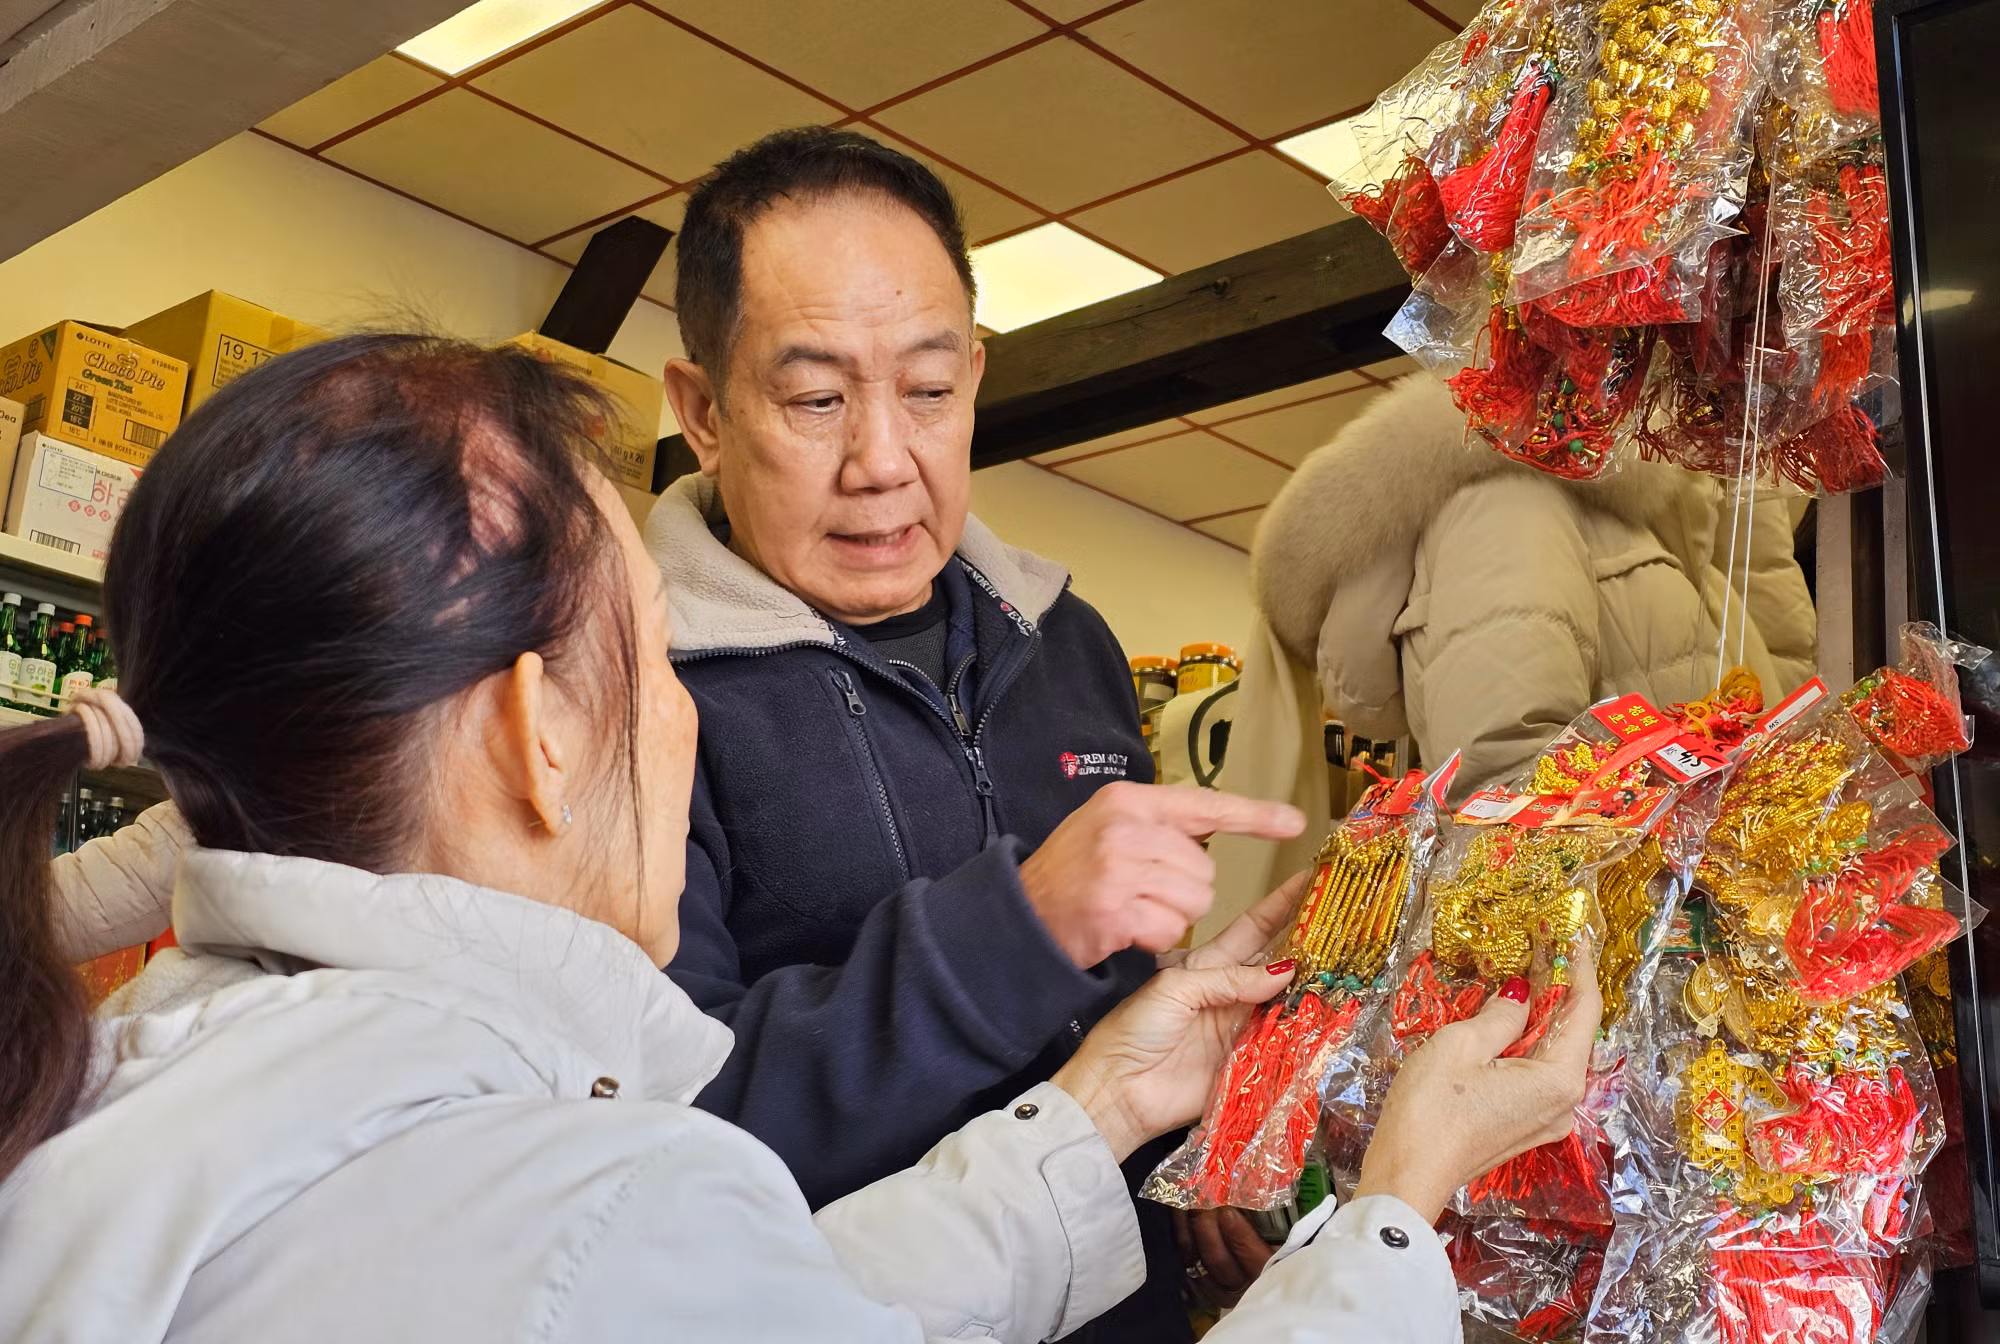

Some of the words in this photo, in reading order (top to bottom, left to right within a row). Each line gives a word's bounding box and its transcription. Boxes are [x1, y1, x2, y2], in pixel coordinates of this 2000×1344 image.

[85, 334, 113, 350] LOTTE
[84, 350, 136, 381] Choco
[135, 367, 166, 391] Pie
[82, 369, 114, 388] Green
[114, 379, 134, 394] Tea
[114, 443, 133, 457] BOXES
[635, 454, 644, 465] 20
